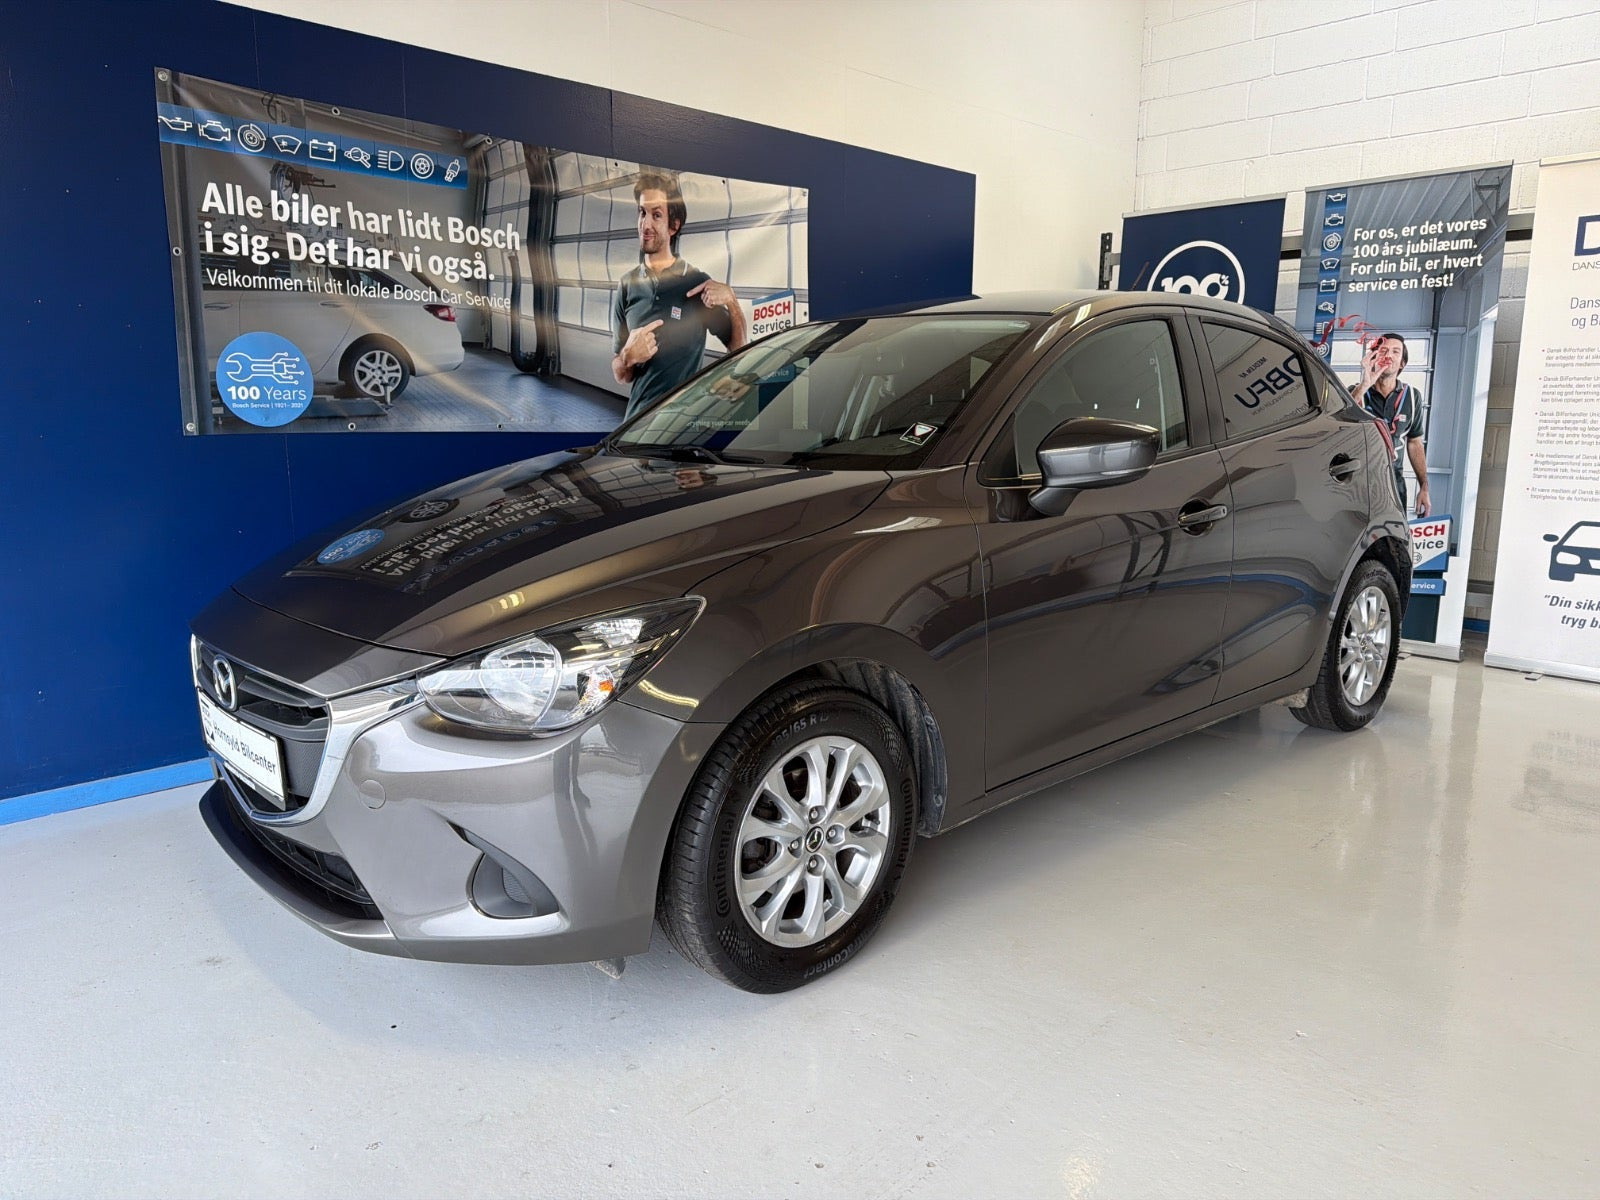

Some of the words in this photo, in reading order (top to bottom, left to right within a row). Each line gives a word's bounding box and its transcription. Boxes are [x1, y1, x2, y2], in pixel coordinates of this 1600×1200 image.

[202, 181, 263, 218] Alle
[271, 190, 341, 227] biler
[346, 201, 392, 235] har
[398, 208, 443, 241] lidt
[447, 216, 520, 250] Bosch
[1353, 228, 1376, 241] For
[1378, 228, 1398, 240] os,
[1401, 225, 1417, 237] er
[1420, 221, 1443, 234] det
[1446, 218, 1487, 233] vores
[204, 221, 213, 253] i
[222, 225, 280, 265] sig.
[286, 232, 339, 265] Det
[346, 237, 393, 270] har
[399, 246, 423, 273] vi
[428, 251, 495, 284] også.
[1352, 243, 1379, 258] 100
[1382, 241, 1403, 257] års
[1405, 237, 1478, 257] jubilæum.
[1350, 262, 1373, 276] For
[1375, 259, 1396, 274] din
[1400, 257, 1421, 273] bil,
[1425, 259, 1440, 271] er
[1443, 253, 1483, 269] hvert
[206, 267, 303, 292] Velkommen
[306, 277, 321, 293] til
[324, 278, 344, 296] dit
[346, 279, 390, 299] lokale
[394, 284, 437, 303] Bosch
[440, 288, 463, 305] Car
[465, 290, 511, 308] Service
[1348, 277, 1398, 293] service
[1401, 278, 1418, 289] en
[1422, 273, 1454, 289] fest!
[753, 301, 791, 321] BOSCH
[752, 319, 791, 334] Service
[1571, 317, 1586, 329] og
[227, 385, 261, 400] 100
[263, 386, 307, 400] Years
[1410, 524, 1445, 538] SCH
[1413, 539, 1444, 550] vice
[1411, 582, 1436, 590] ervice
[1561, 615, 1587, 629] tryg
[240, 741, 276, 775] Bilcenter
